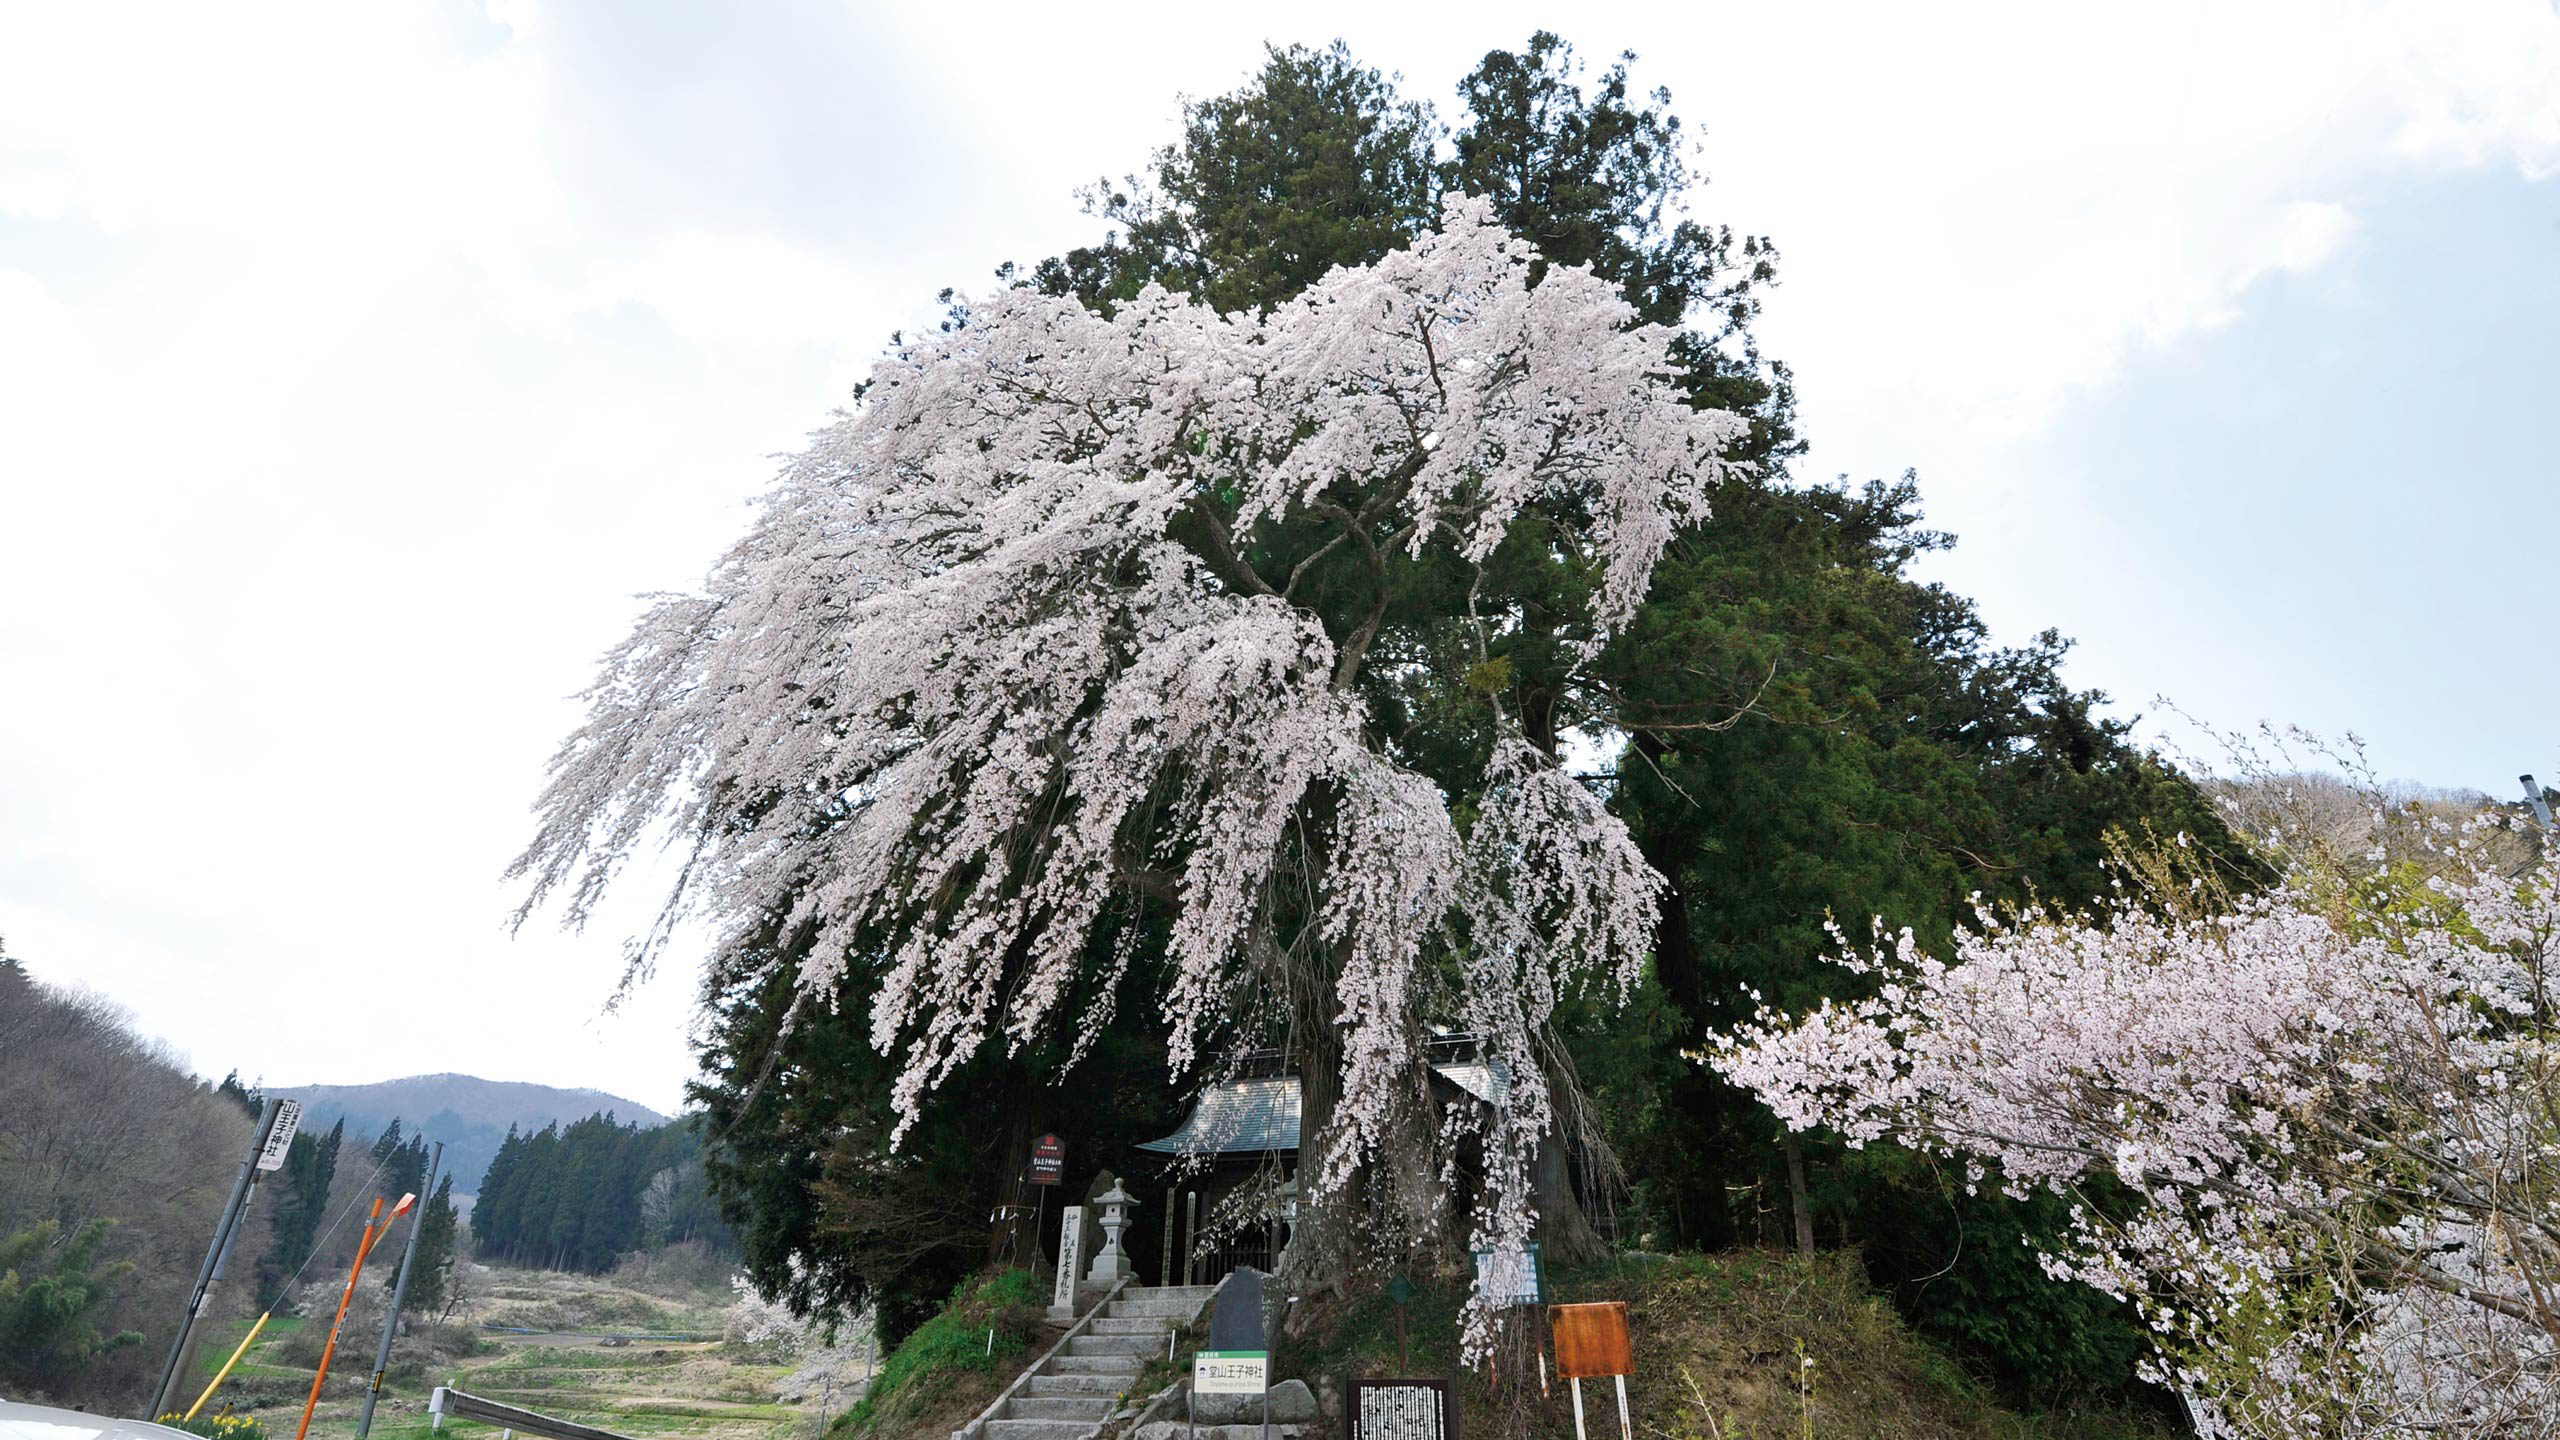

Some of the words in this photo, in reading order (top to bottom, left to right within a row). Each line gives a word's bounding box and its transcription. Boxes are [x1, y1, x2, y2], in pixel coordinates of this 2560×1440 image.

[1208, 1364, 1263, 1379] 堂山王子神社
